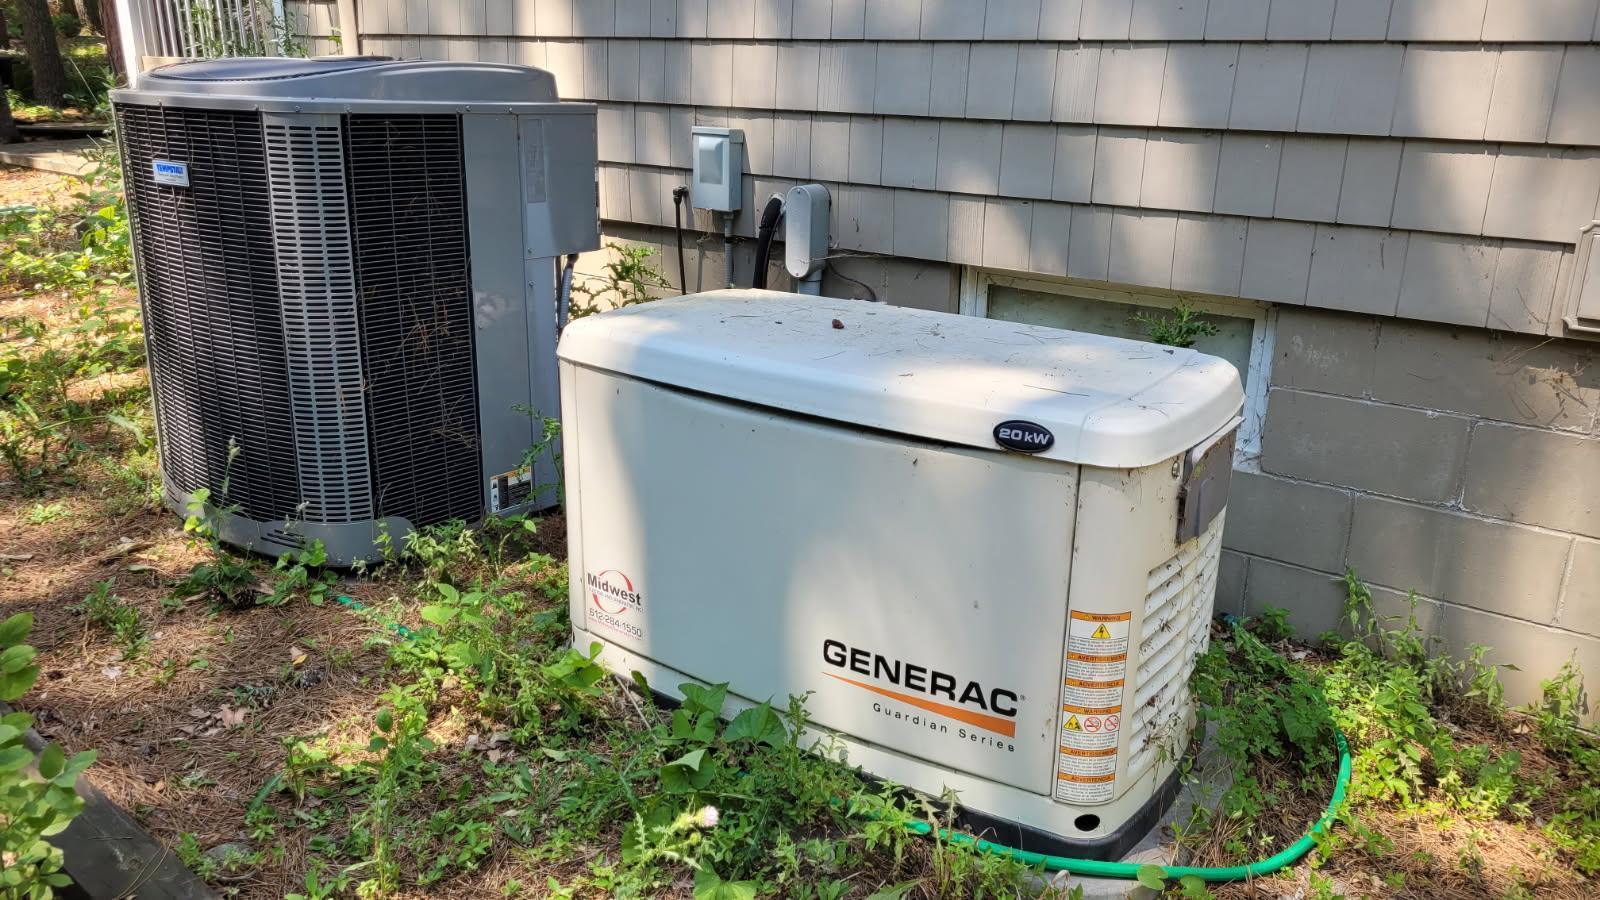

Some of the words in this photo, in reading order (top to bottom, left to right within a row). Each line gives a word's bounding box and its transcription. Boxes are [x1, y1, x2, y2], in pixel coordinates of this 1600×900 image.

[998, 428, 1023, 440] 20
[1024, 431, 1050, 445] kW
[587, 573, 642, 606] Midwest
[823, 638, 1019, 718] GENERAC
[873, 702, 948, 733] Guardian
[958, 728, 1015, 752] Series
